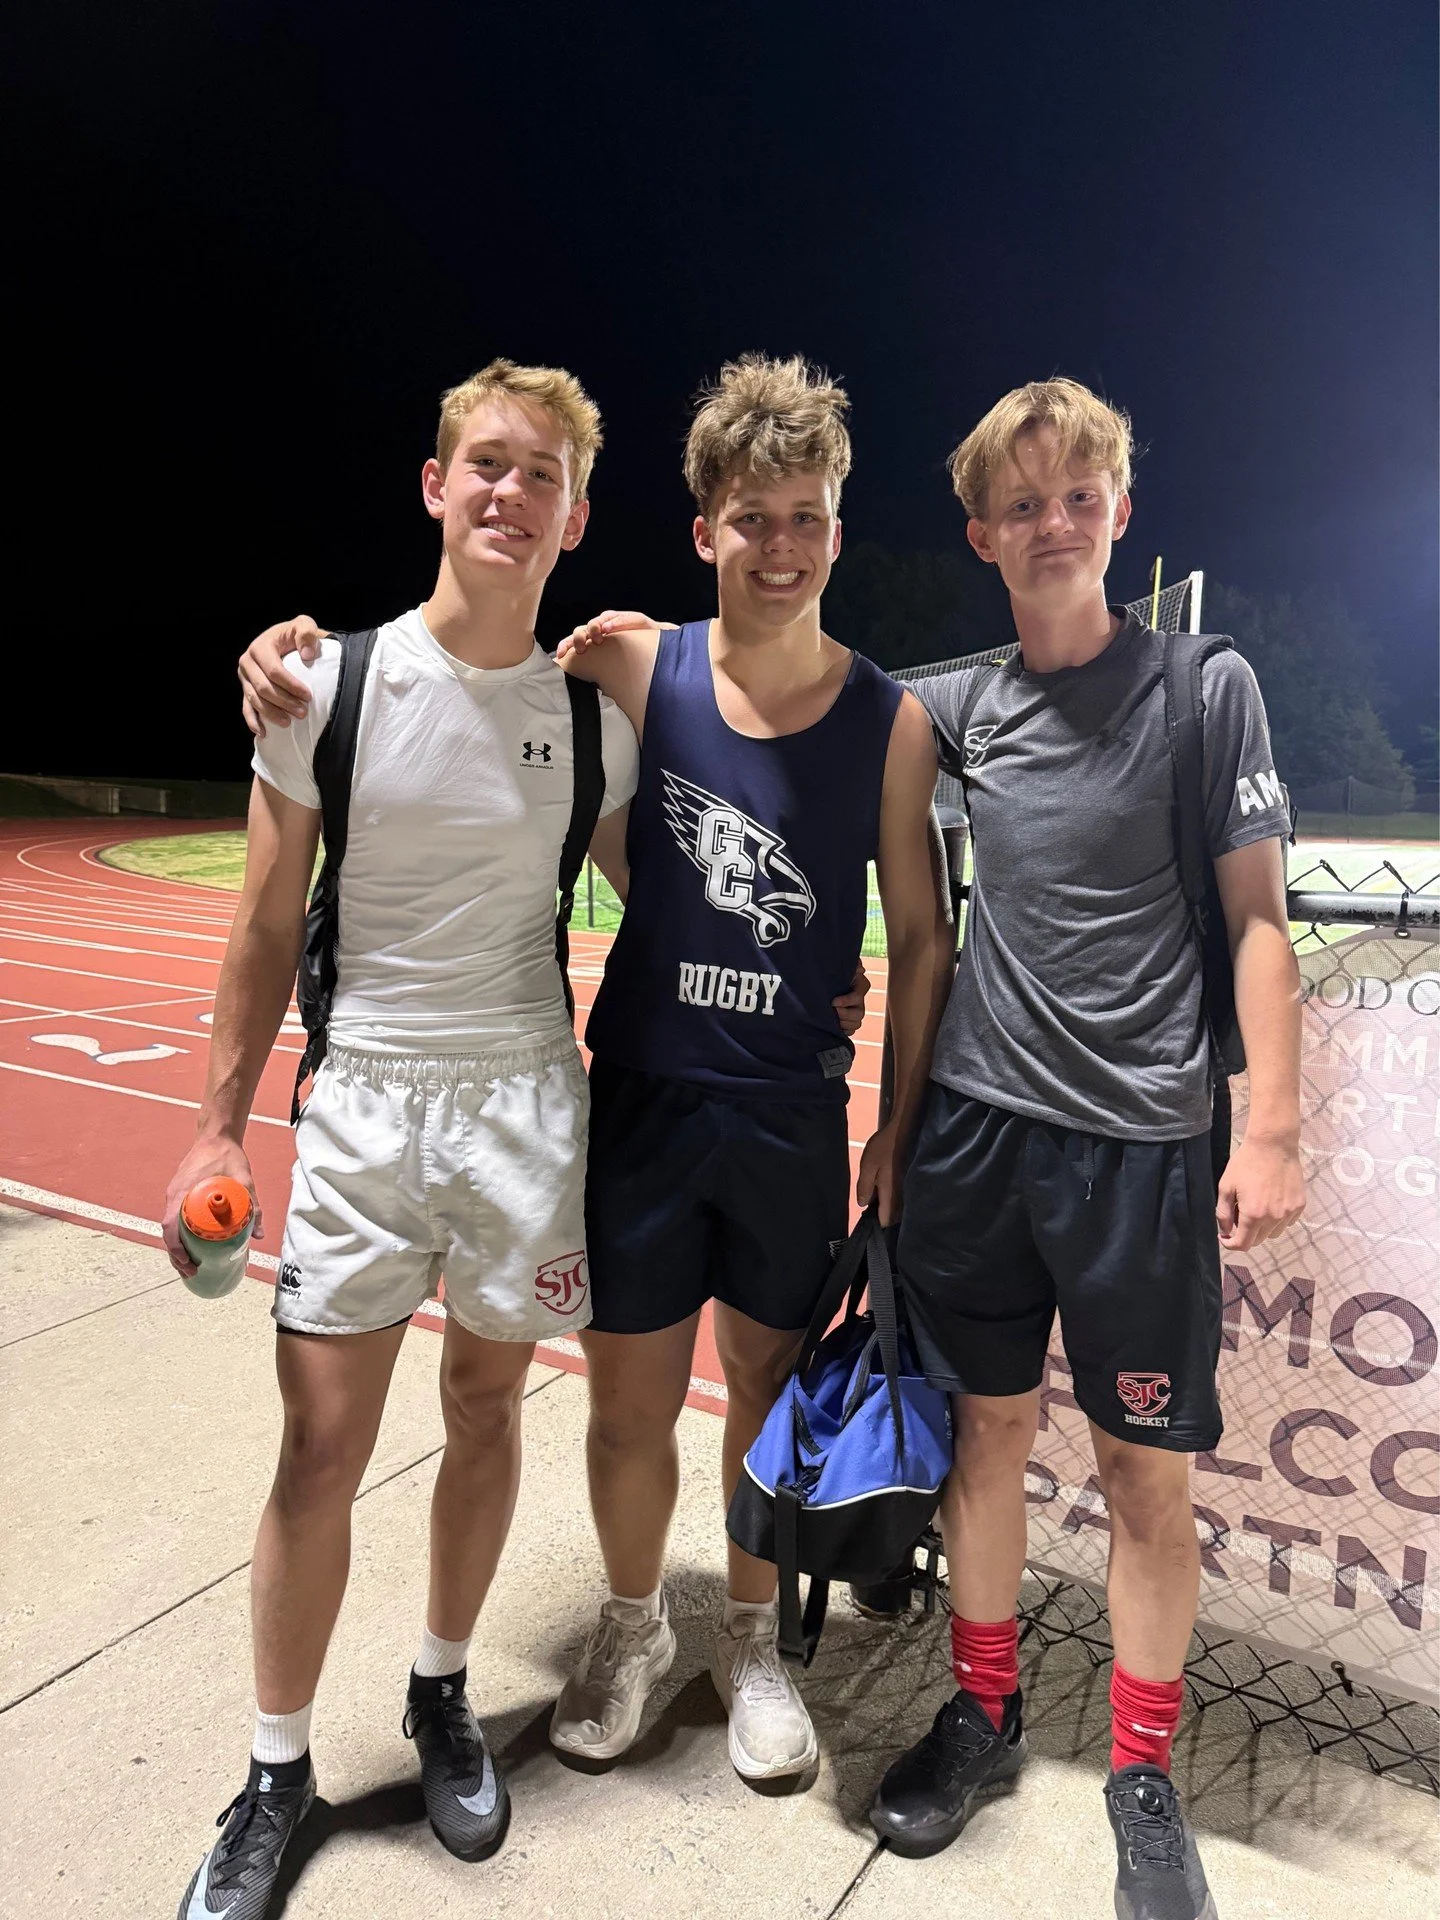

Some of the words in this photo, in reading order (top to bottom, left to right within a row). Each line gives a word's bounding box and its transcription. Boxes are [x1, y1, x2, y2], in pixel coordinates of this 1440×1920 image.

[1237, 769, 1284, 816] AM
[678, 962, 782, 1015] RUGBY
[1303, 1027, 1440, 1078] MM
[1331, 1087, 1440, 1137] RT
[1116, 1378, 1172, 1409] SJC
[1124, 1413, 1170, 1428] HOCKEY
